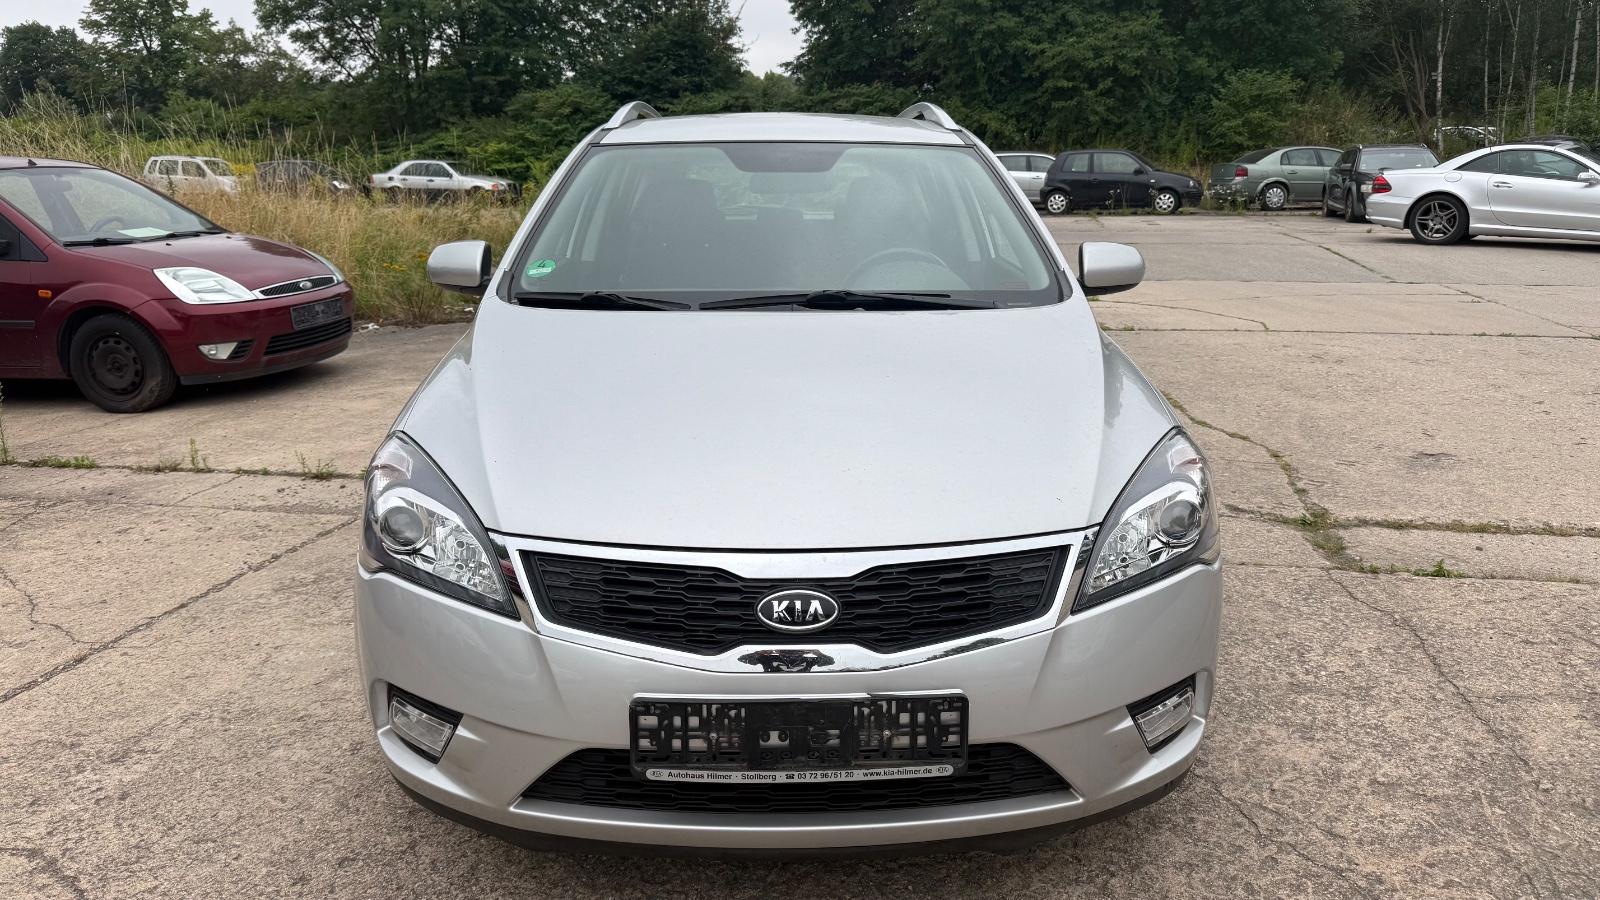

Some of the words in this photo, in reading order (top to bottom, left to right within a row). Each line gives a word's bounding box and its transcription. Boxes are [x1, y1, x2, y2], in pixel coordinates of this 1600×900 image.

[537, 259, 546, 268] 4
[771, 600, 826, 621] KIA
[667, 771, 705, 780] Autohaus
[706, 772, 733, 780] Hilmer
[741, 773, 777, 781] Stollberg
[820, 772, 842, 780] 96/51
[844, 771, 854, 779] 20
[862, 767, 933, 778] www.kia-hilmer.de
